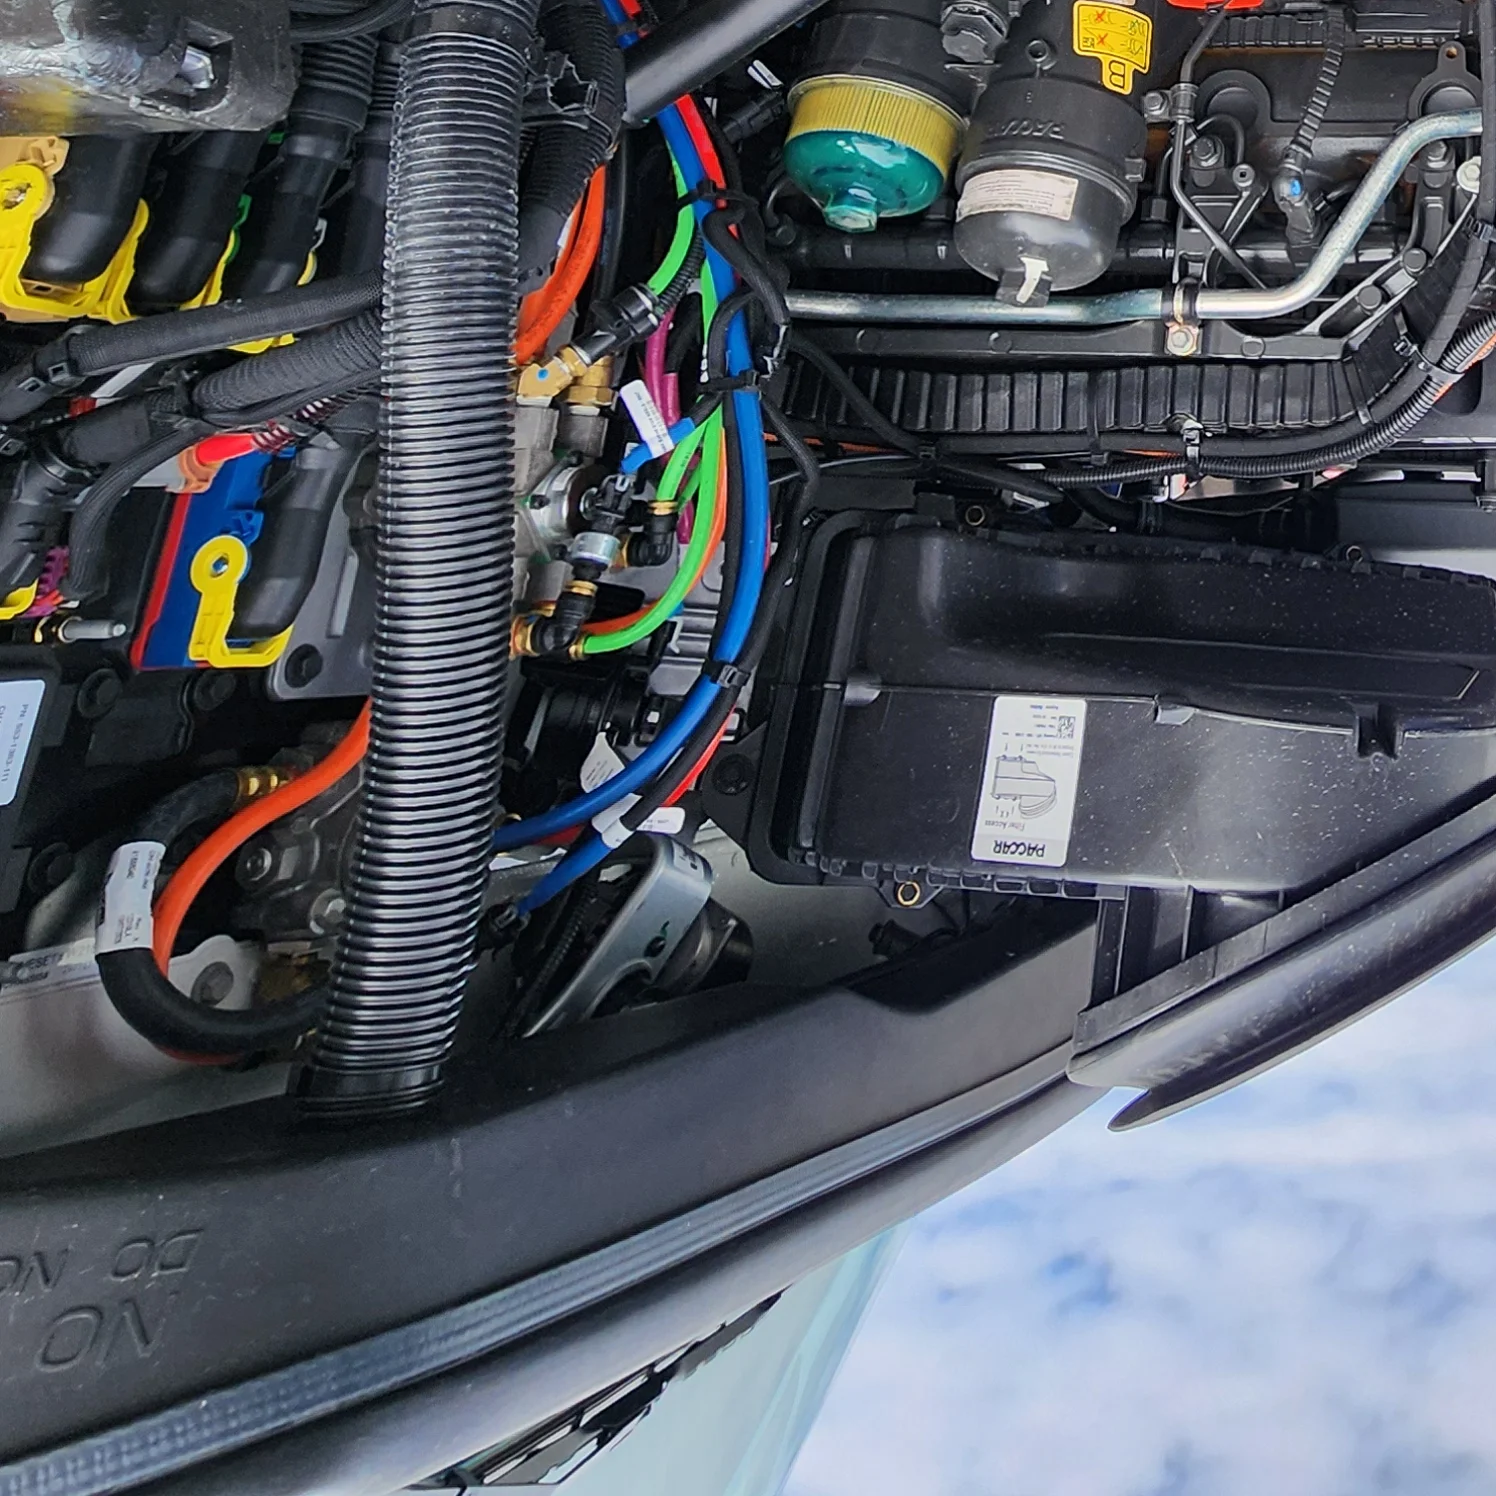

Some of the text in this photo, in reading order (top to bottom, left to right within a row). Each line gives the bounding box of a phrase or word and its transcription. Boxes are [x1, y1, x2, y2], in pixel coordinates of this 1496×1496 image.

[1108, 60, 1126, 90] B
[984, 820, 1007, 830] Access
[993, 840, 1046, 858] PACCAR
[109, 1229, 204, 1282] DO
[33, 1291, 179, 1373] NO
